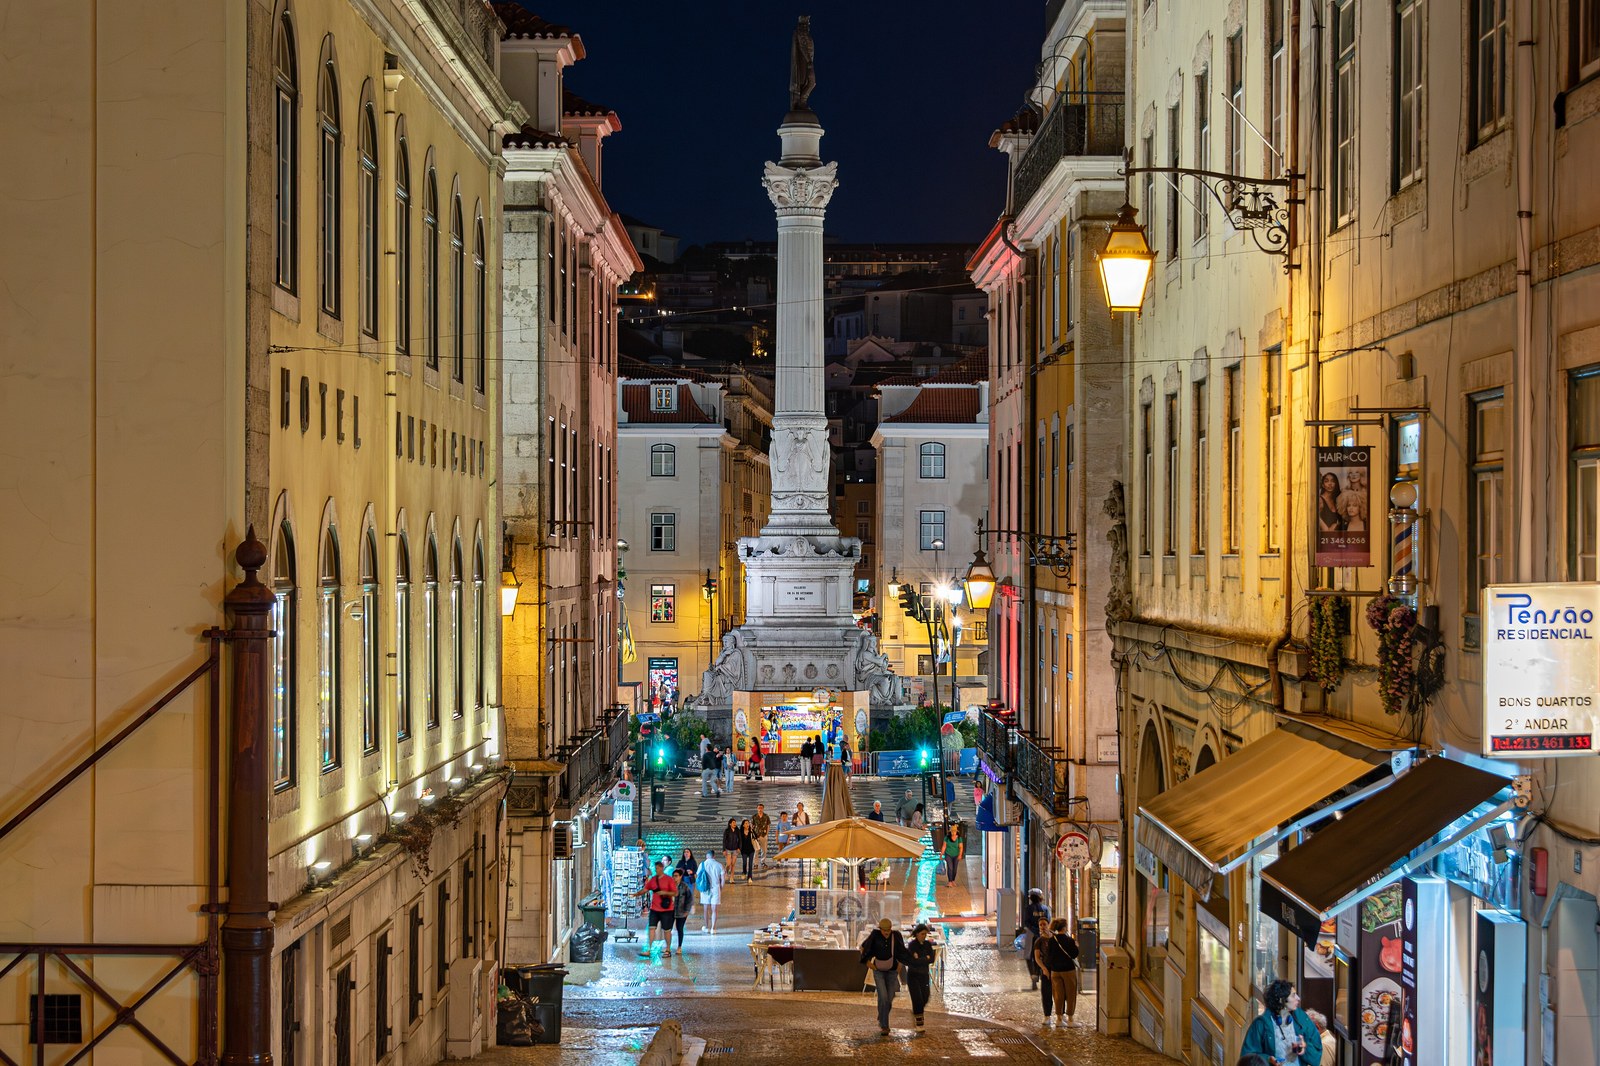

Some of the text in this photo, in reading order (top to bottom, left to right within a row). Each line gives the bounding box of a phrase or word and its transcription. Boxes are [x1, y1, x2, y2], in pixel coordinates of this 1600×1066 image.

[281, 367, 485, 478] HOTEL AMERICANO
[1496, 593, 1593, 624] Pensão
[1497, 628, 1592, 640] RESIDENCIAL
[1499, 696, 1592, 707] BONS QUARTOS
[1524, 718, 1568, 729] ANDAR
[1542, 737, 1564, 749] 461
[1568, 736, 1591, 749] 133
